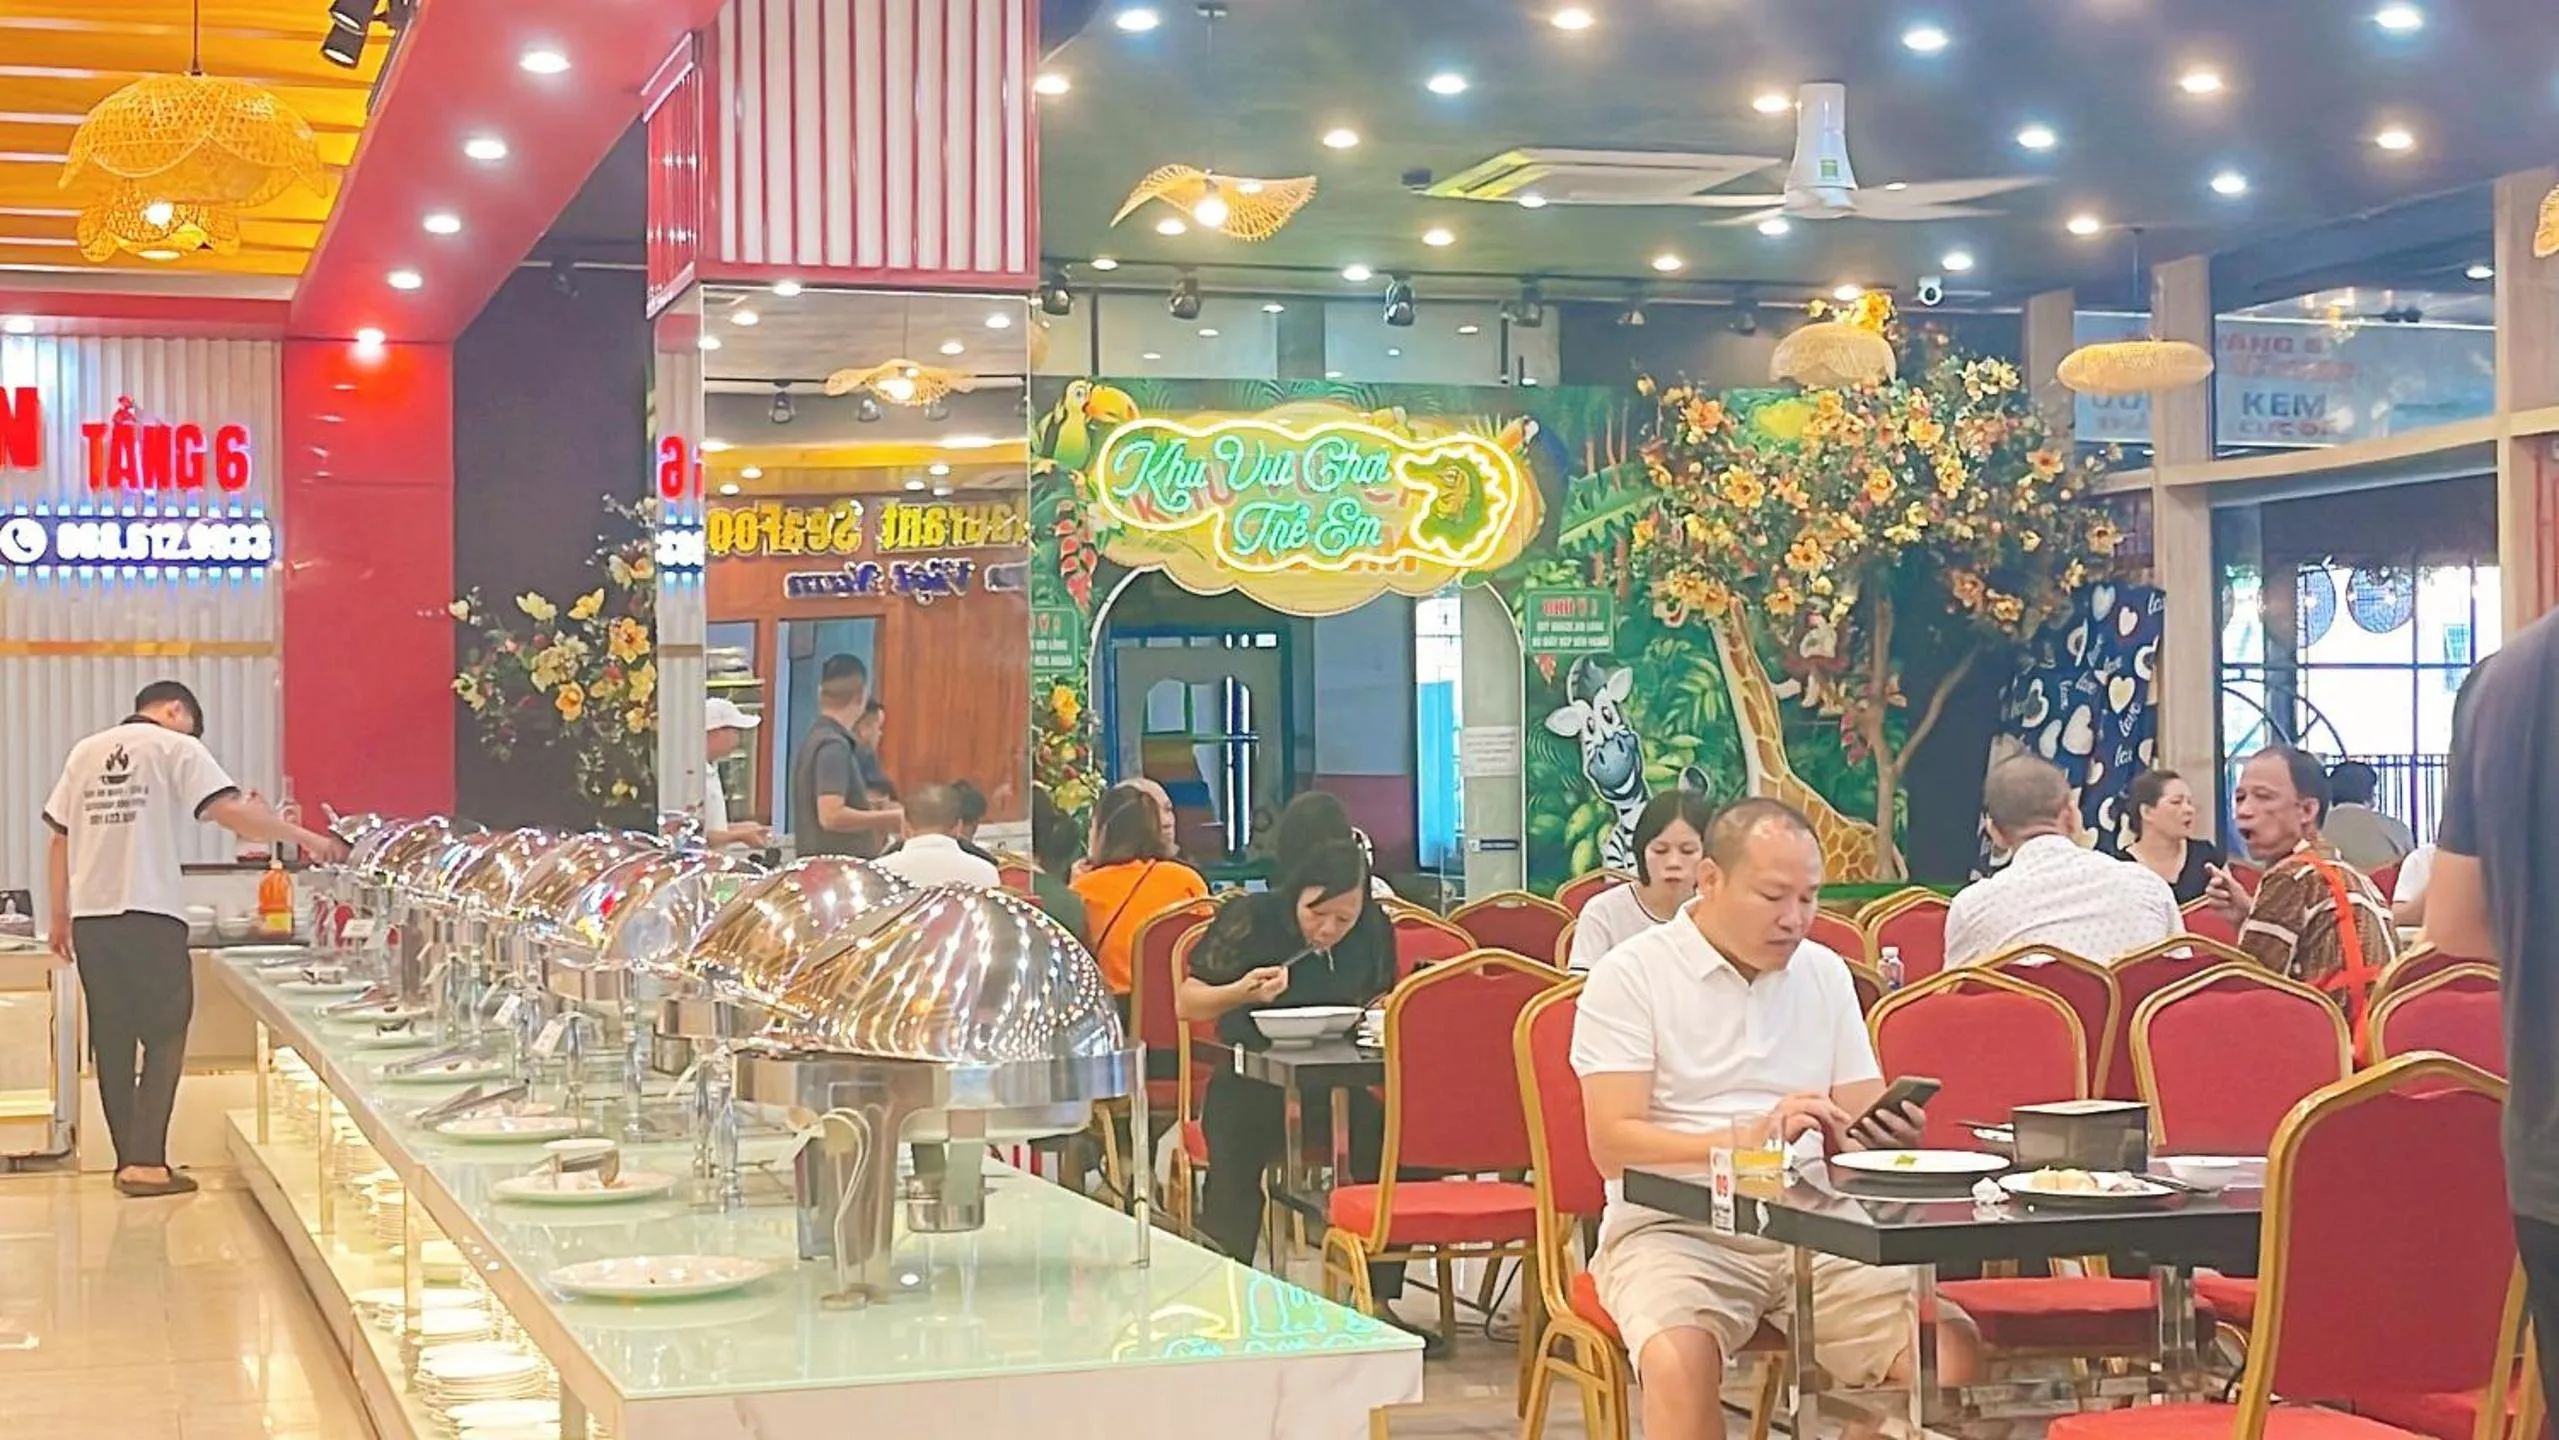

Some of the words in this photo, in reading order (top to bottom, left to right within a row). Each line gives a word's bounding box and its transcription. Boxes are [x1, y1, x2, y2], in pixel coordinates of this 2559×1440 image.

[2242, 390, 2328, 417] KEM
[82, 395, 208, 491] TẦNG
[214, 423, 250, 491] 6
[1112, 437, 1208, 513] Khu
[1212, 434, 1294, 490] Vui
[1314, 497, 1382, 557] Em
